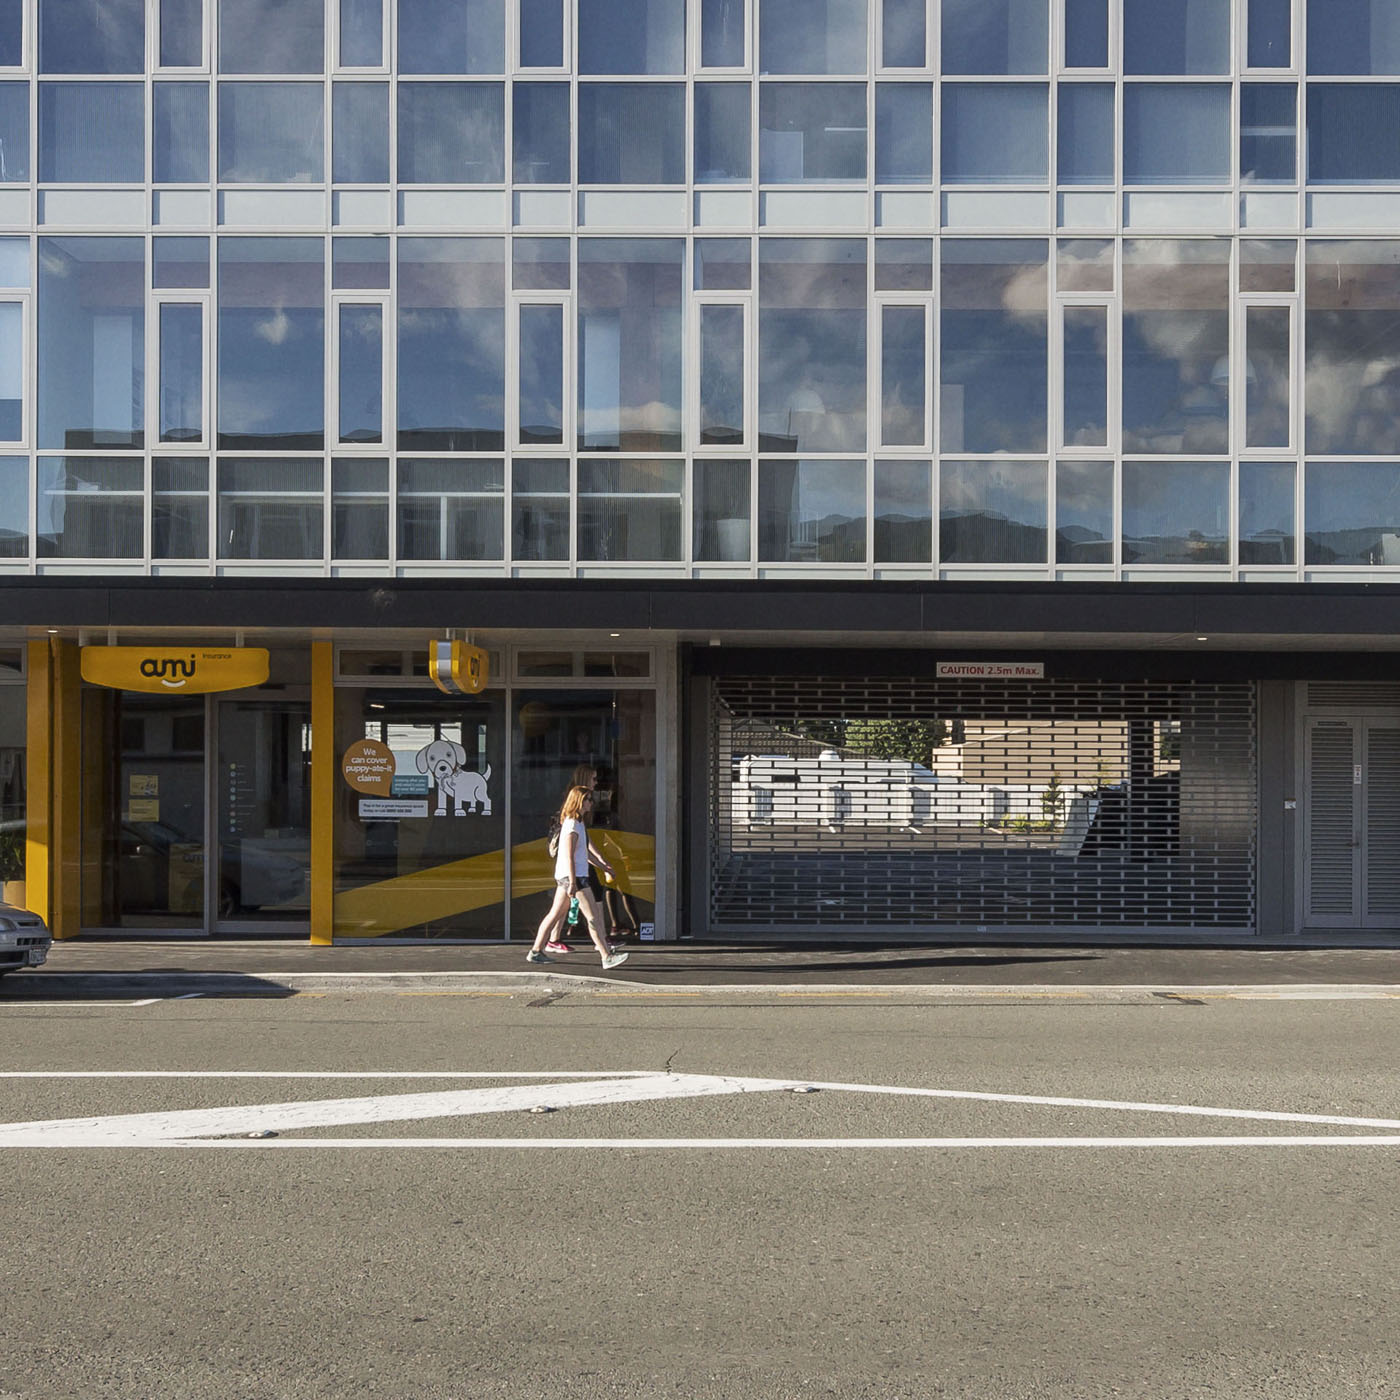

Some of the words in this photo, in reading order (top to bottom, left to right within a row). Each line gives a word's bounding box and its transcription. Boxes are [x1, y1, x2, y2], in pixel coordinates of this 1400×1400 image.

[140, 653, 196, 677] ami
[940, 666, 985, 675] CAUTION
[987, 666, 1013, 675] 2.5m
[1015, 667, 1040, 675] Max.
[363, 748, 377, 756] We
[356, 774, 382, 782] claims
